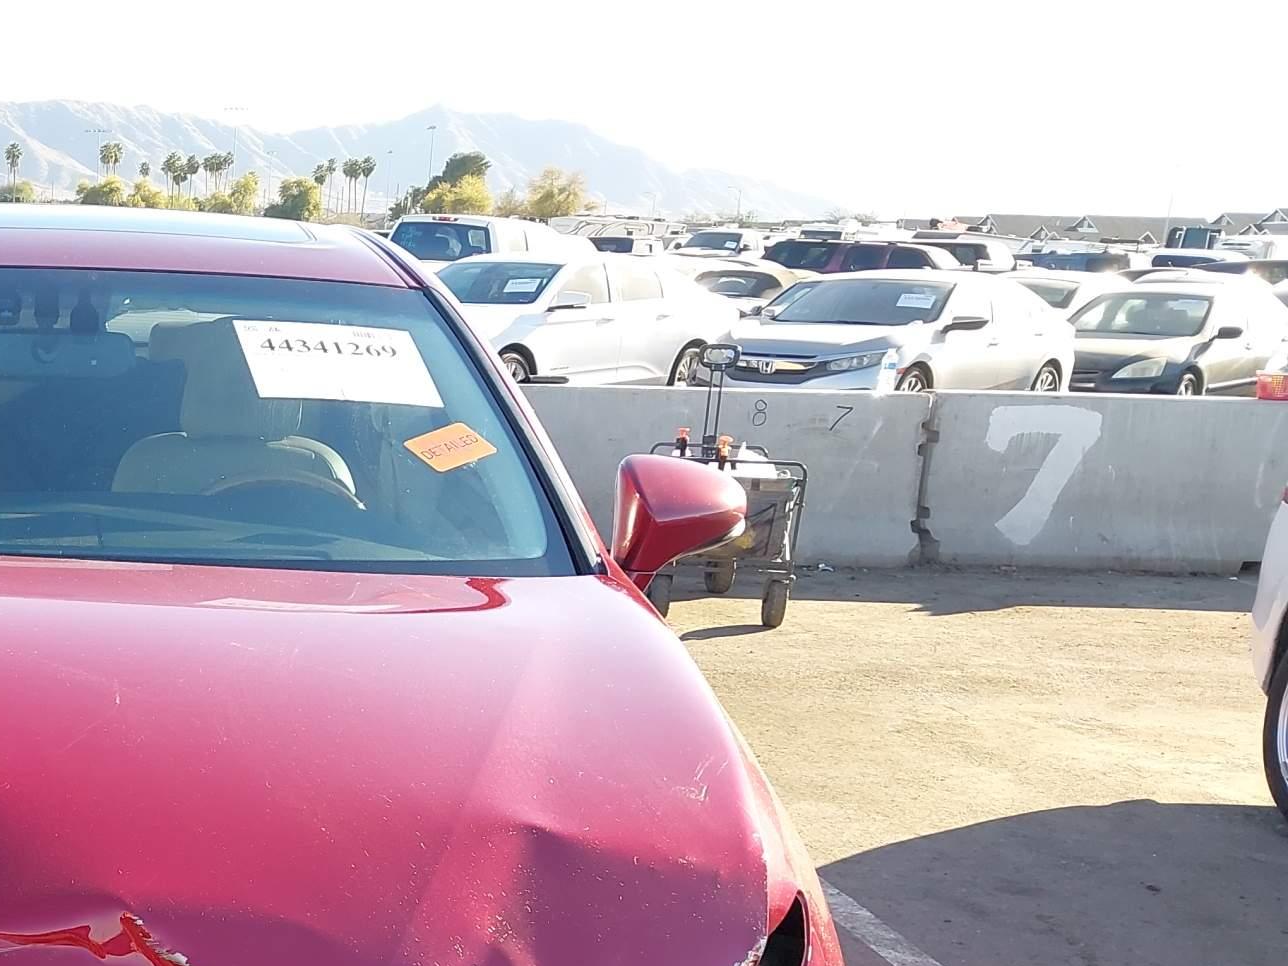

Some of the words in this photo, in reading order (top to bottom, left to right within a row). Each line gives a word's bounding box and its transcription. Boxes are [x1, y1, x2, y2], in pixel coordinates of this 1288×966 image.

[260, 338, 398, 358] 44341269
[753, 399, 767, 426] 8
[829, 405, 853, 431] 7
[420, 434, 479, 460] DETAILED
[988, 405, 1102, 545] 7
